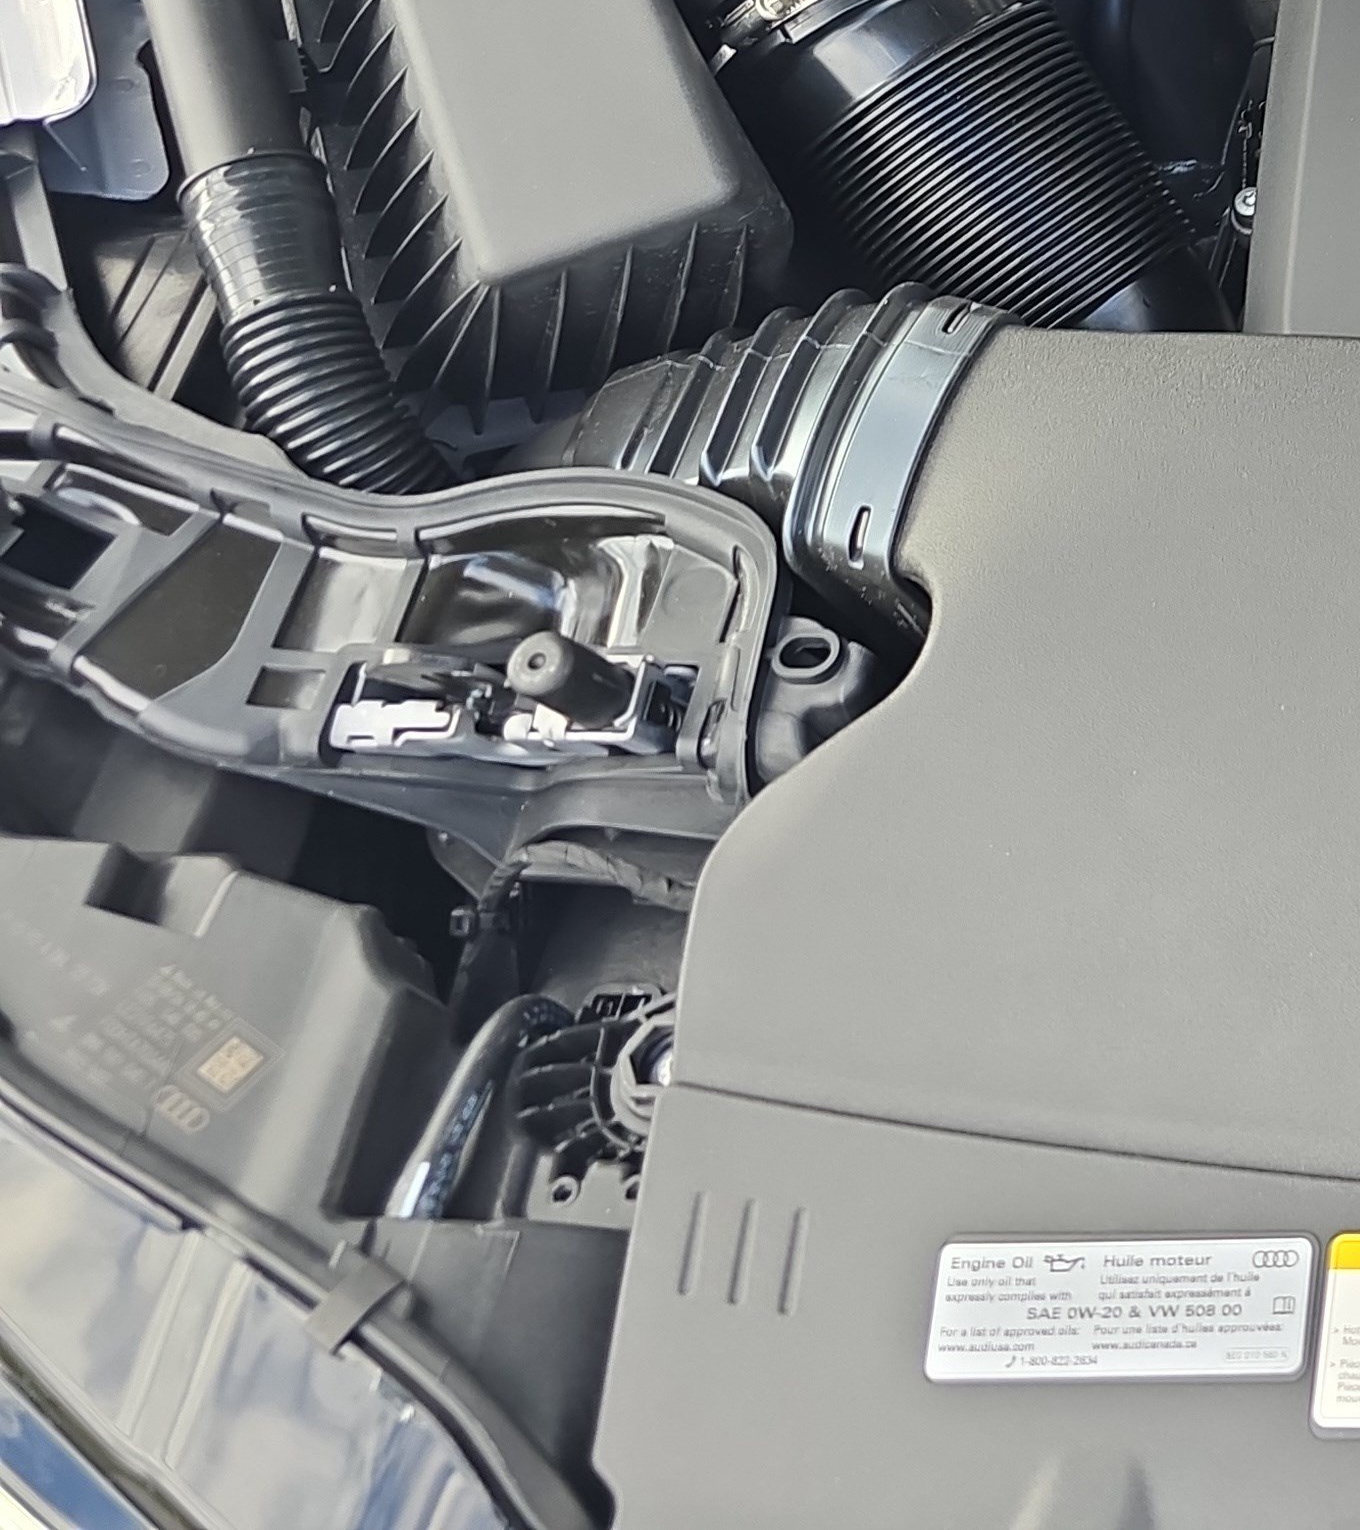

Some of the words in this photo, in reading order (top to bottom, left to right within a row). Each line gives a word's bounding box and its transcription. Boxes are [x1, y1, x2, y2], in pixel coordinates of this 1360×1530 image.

[951, 1256, 1006, 1272] Engine
[1012, 1256, 1034, 1269] Oil
[1103, 1255, 1144, 1267] Huile
[1151, 1255, 1213, 1267] moteur
[947, 1276, 968, 1287] Use
[971, 1277, 994, 1288] only
[998, 1276, 1011, 1286] oil
[1015, 1276, 1037, 1286] that
[1100, 1274, 1138, 1285] Utilisez
[1142, 1273, 1207, 1286] uniquement
[1210, 1272, 1224, 1283] de
[1227, 1271, 1260, 1282] l'huile
[945, 1291, 994, 1303] expressly
[998, 1291, 1046, 1303] complies
[1049, 1291, 1072, 1301] with
[1098, 1289, 1116, 1301] qui
[1119, 1288, 1162, 1299] satisfait
[1026, 1306, 1062, 1320] SAE
[1067, 1305, 1123, 1319] 0W-20
[1128, 1305, 1141, 1319] &
[1149, 1304, 1181, 1318] VW
[1185, 1304, 1216, 1317] 508
[1221, 1303, 1243, 1317] 00
[940, 1326, 958, 1337] For
[961, 1328, 967, 1337] a
[970, 1326, 987, 1336] list
[989, 1325, 1001, 1336] of
[1003, 1326, 1055, 1338] approved
[1094, 1324, 1118, 1334] Pour
[1122, 1325, 1142, 1334] une
[1146, 1324, 1168, 1334] liste
[1172, 1323, 1214, 1333] d'huiles
[1343, 1326, 1360, 1335] Hot
[938, 1341, 1035, 1353] www.audiusa.com
[1092, 1339, 1198, 1350] www.audicanada.ca
